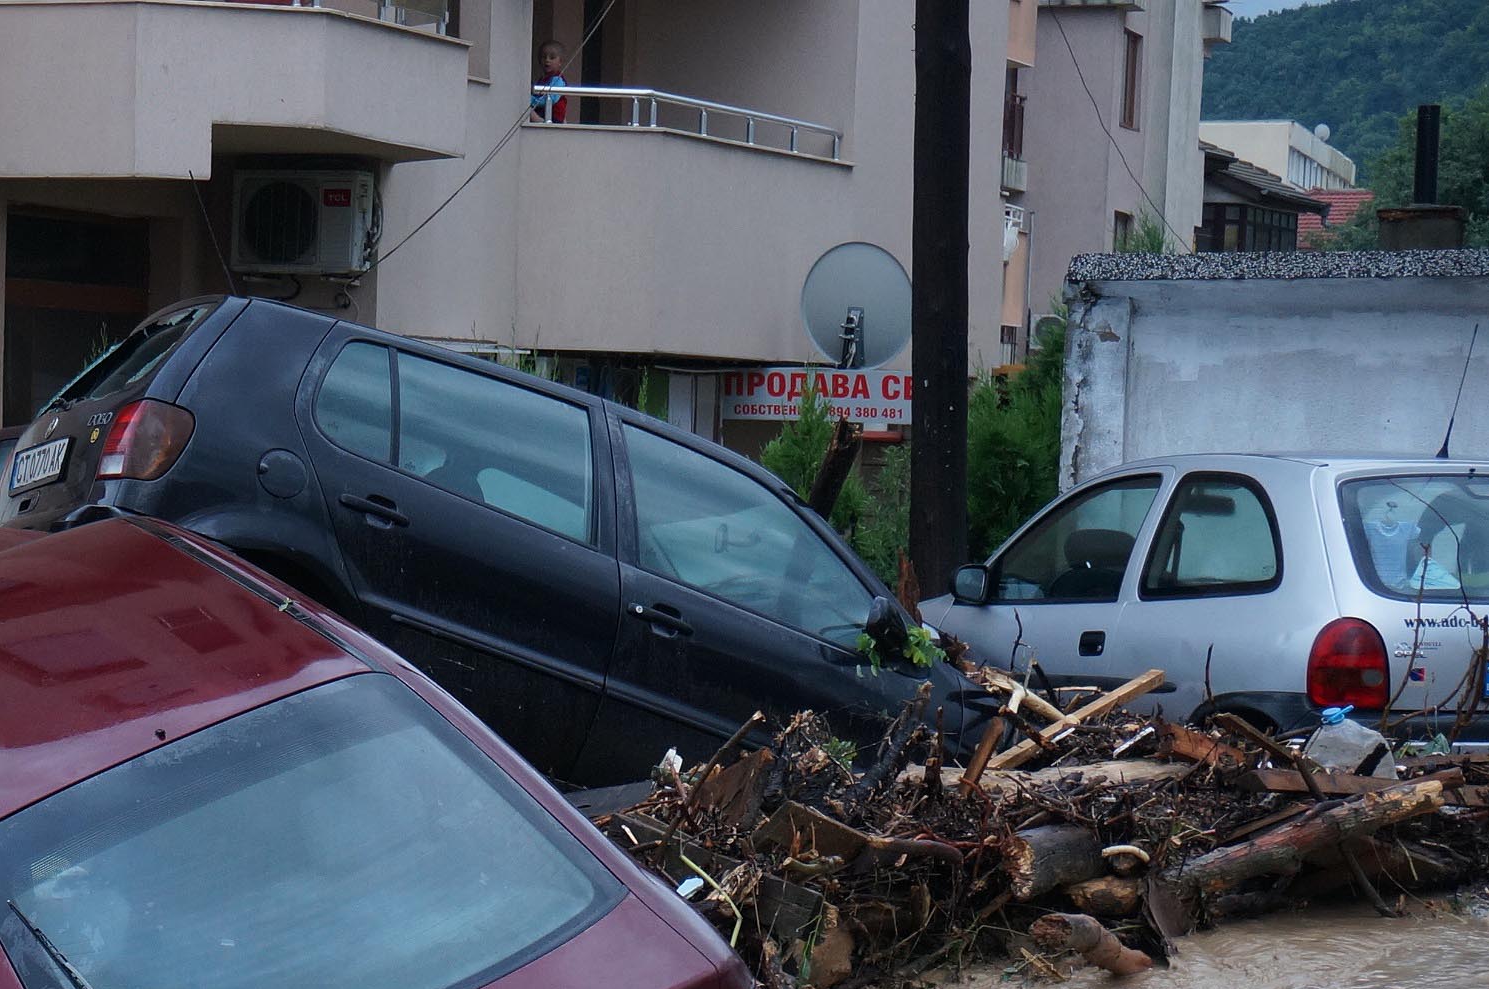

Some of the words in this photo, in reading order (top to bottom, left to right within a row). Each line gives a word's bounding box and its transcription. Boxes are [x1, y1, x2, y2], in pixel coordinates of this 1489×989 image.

[724, 372, 871, 401] ПРОДАВА
[821, 406, 851, 418] 894
[855, 406, 878, 419] 380
[881, 408, 904, 419] 481
